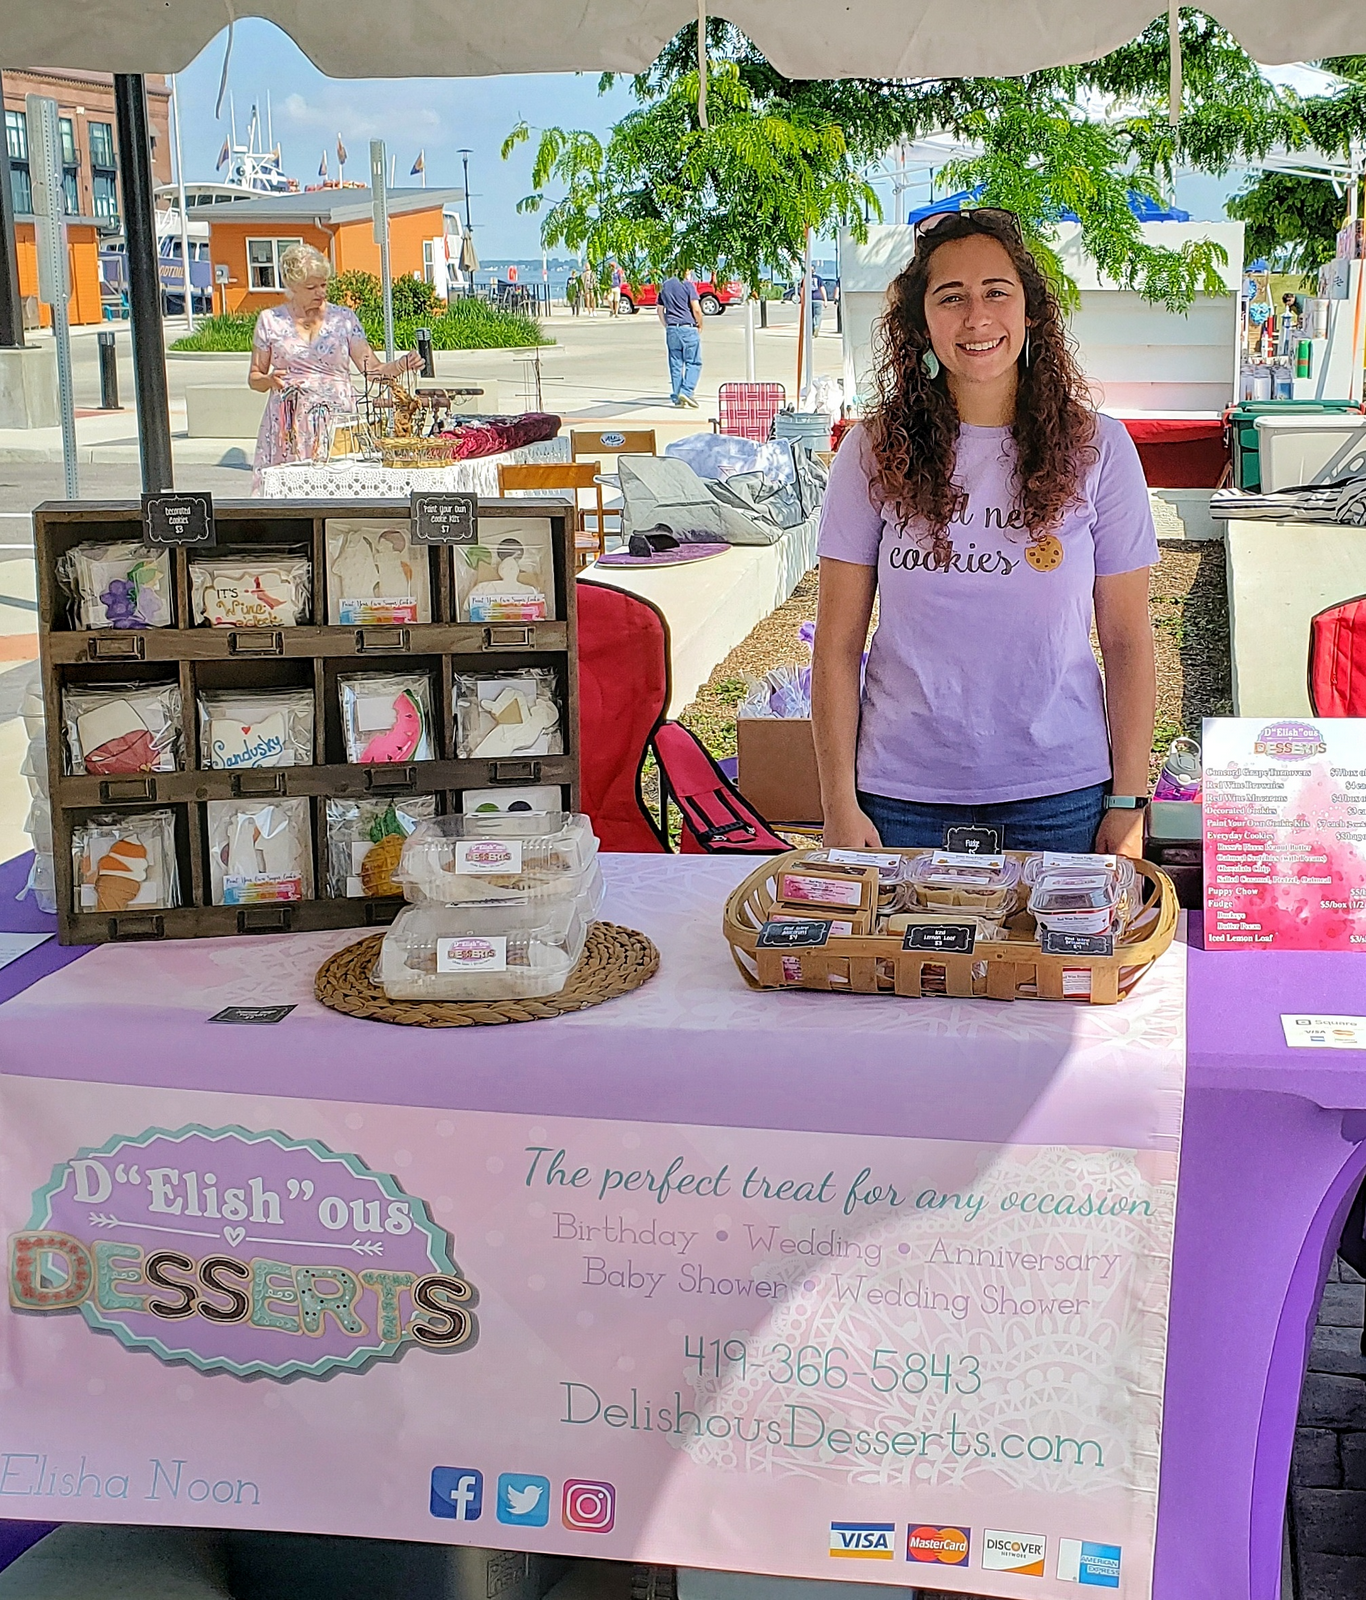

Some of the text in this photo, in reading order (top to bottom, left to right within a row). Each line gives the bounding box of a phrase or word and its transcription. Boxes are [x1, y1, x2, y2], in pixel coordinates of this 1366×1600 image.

[175, 525, 184, 534] $3
[441, 525, 450, 533] $7
[889, 542, 1020, 576] cookies
[216, 588, 239, 600] IT'S
[216, 600, 267, 617] Wine
[212, 734, 284, 769] Sandusky
[1253, 741, 1327, 755] DESSERTS
[1205, 768, 1241, 777] Concord
[1242, 768, 1268, 778] Grape
[1268, 768, 1312, 777] Turnovers
[1205, 781, 1223, 790] Red
[1223, 781, 1246, 790] Wine
[1246, 781, 1285, 790] Brownies
[1205, 794, 1223, 803] Red
[1223, 794, 1246, 803] Wine
[1246, 794, 1288, 803] Macarons
[1205, 807, 1246, 815] Decorated
[1246, 807, 1277, 815] Cookies
[1206, 819, 1227, 828] Paint
[1227, 819, 1246, 828] Your
[1246, 819, 1266, 828] Own
[1266, 819, 1295, 828] Cookie
[1294, 819, 1311, 828] Kits
[1327, 819, 1345, 828] each
[1206, 832, 1243, 841] Everyday
[1243, 832, 1275, 840] Cookies
[1217, 876, 1239, 884] Salted
[1207, 887, 1233, 897] Puppy
[1235, 887, 1258, 895] Chow
[1207, 900, 1233, 908] Fudge
[1320, 900, 1347, 909] $5/box
[1208, 934, 1225, 942] Iced
[1226, 934, 1254, 942] Lemon
[1254, 934, 1274, 942] Loaf
[525, 1146, 1158, 1223] The perfect treat for any occasion
[552, 1211, 1122, 1280] Birthday Wedding Anniversary
[8, 1231, 475, 1349] DESSERTS
[581, 1255, 1091, 1321] Baby Shower Wedding Shower
[683, 1334, 983, 1396] 419-366-5843
[559, 1381, 1105, 1468] DelishousDesserts.com
[0, 1453, 261, 1506] Elisha Noon
[838, 1531, 889, 1550] VISA
[909, 1535, 967, 1553] MasterCard
[986, 1538, 1043, 1556] DISCOVER
[1001, 1551, 1027, 1559] NETWORK
[1080, 1556, 1118, 1567] AMERICAN
[1088, 1565, 1120, 1576] EXPRESS
